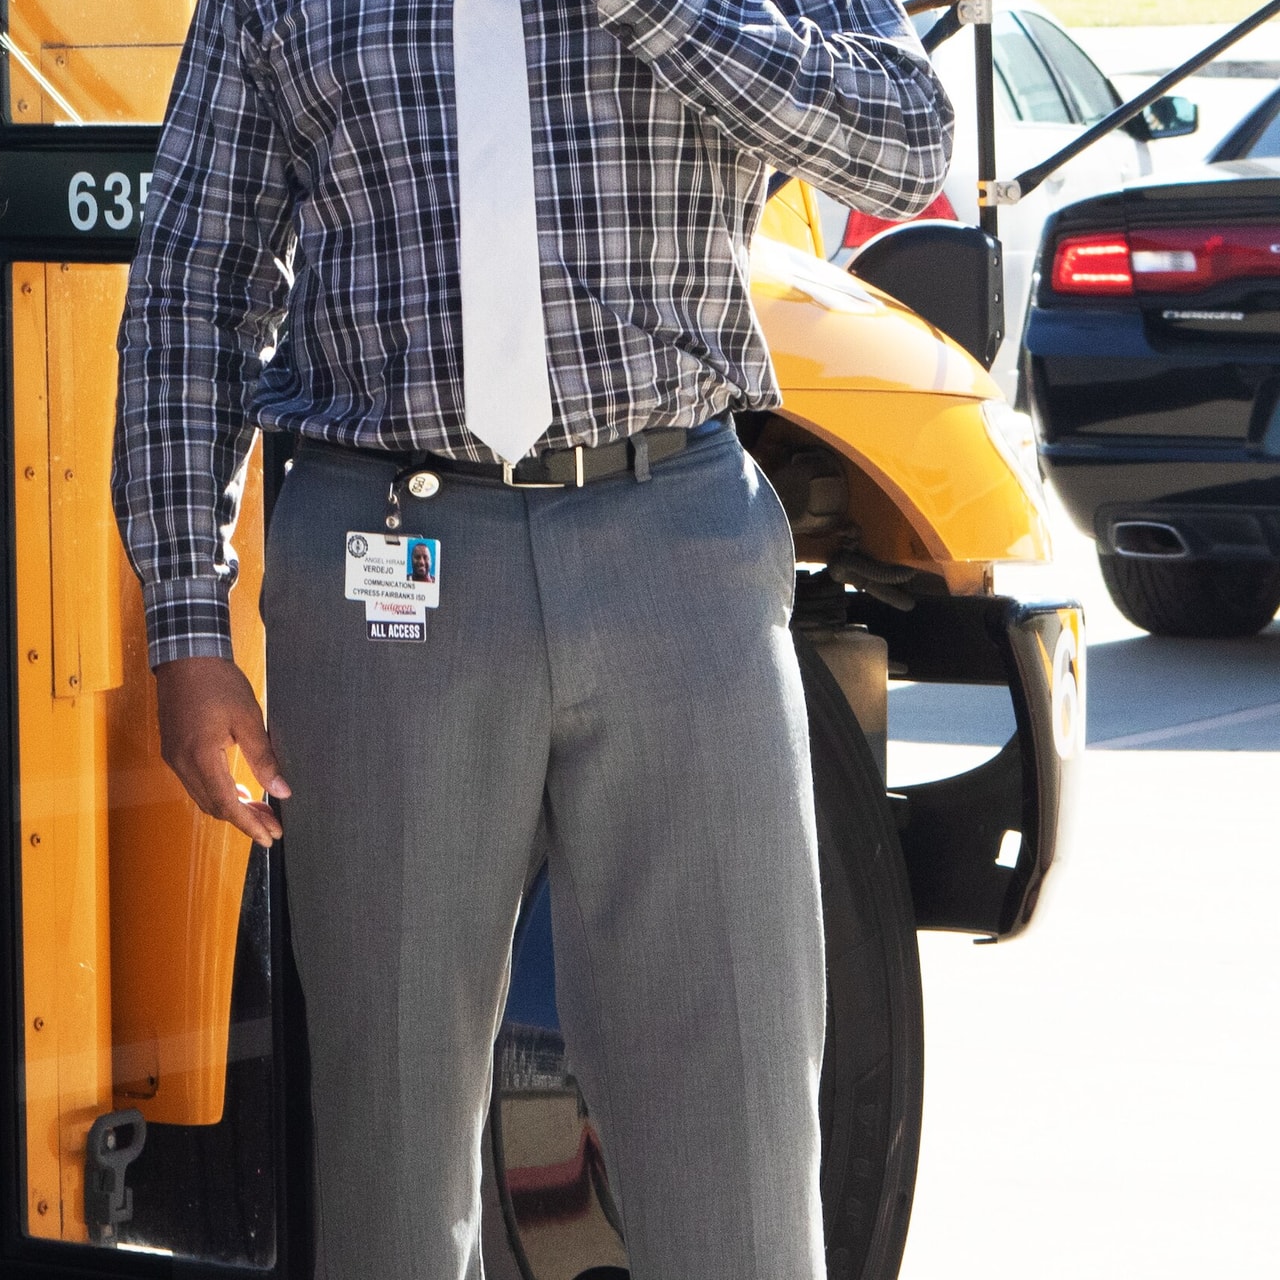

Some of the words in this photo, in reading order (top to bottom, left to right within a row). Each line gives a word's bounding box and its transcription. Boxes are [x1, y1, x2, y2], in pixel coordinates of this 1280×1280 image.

[363, 565, 394, 574] VERDEJO
[364, 578, 416, 590] COMMUNICATIONS
[371, 624, 386, 638] ALL
[388, 625, 420, 638] ACCESS
